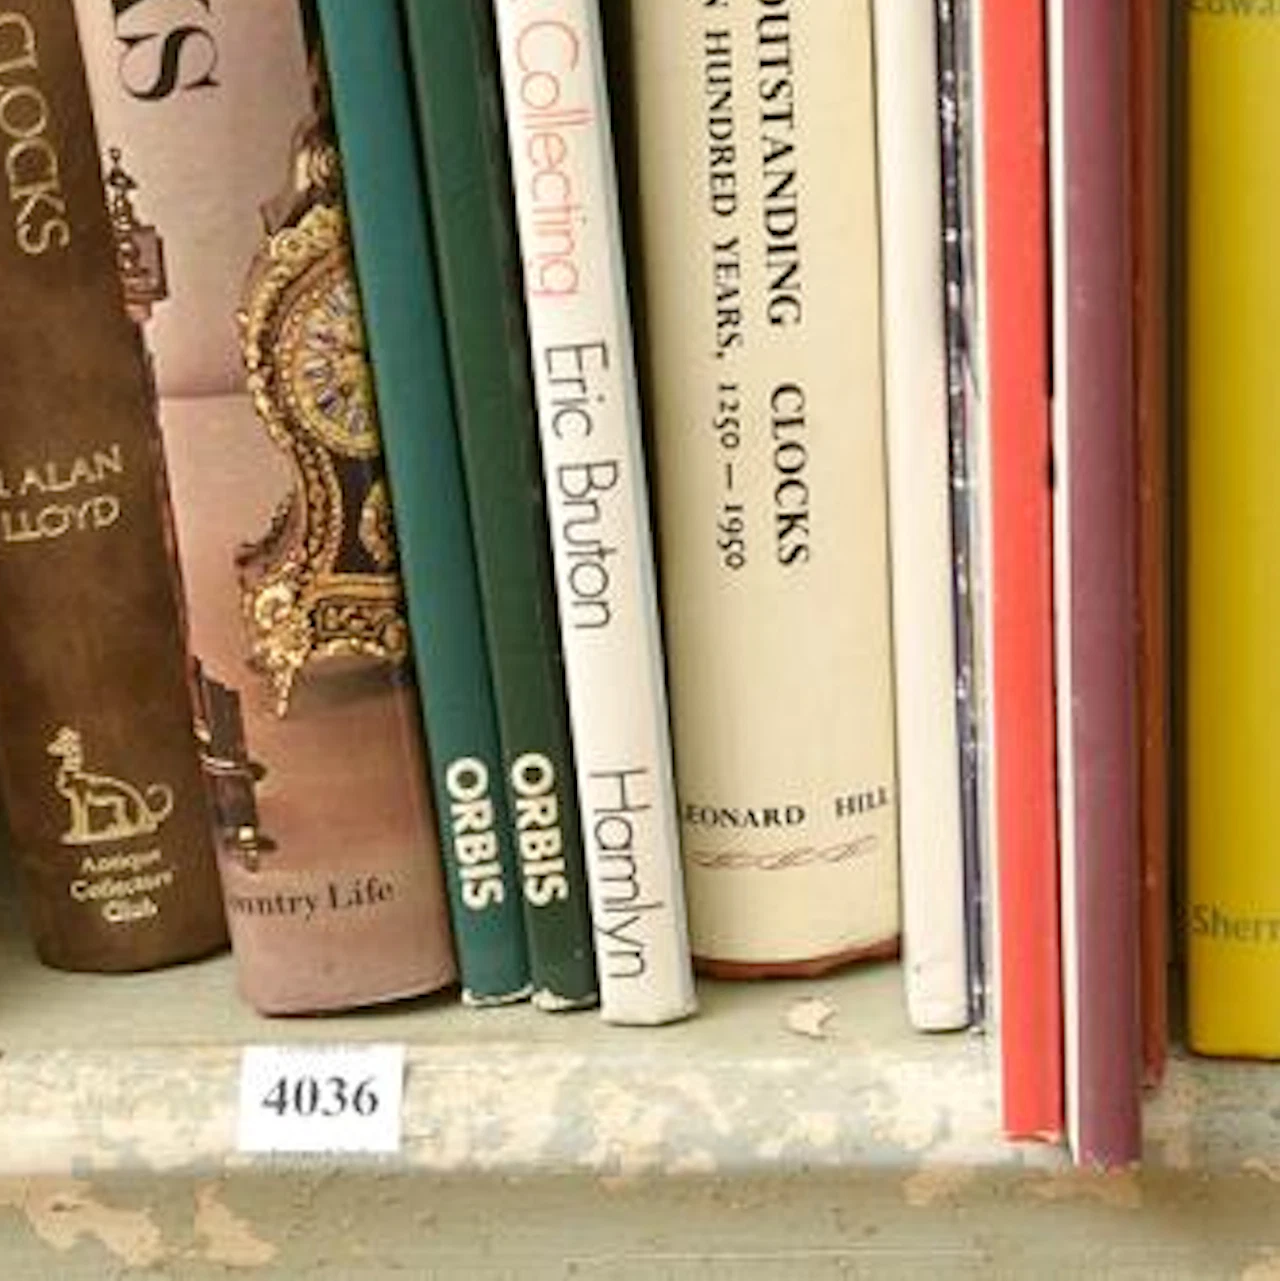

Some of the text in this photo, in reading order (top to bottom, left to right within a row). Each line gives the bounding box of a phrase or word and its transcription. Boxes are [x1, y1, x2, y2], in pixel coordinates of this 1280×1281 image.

[515, 19, 594, 300] Collecting
[703, 30, 739, 221] HUNDRED
[711, 236, 746, 360] YEARS,
[543, 338, 612, 441] Eric
[717, 382, 741, 452] 1250
[2, 494, 120, 543] LLOYD
[20, 443, 122, 494] ALAN
[770, 381, 811, 568] CLOCKS
[557, 458, 621, 631] Bruton
[721, 501, 747, 572] 1950
[445, 756, 504, 912] ORBIS
[510, 752, 569, 909] ORBIS
[683, 786, 891, 833] EONARD HILL
[231, 875, 396, 919] ountry Life
[589, 765, 665, 982] Hamlyn
[260, 1073, 381, 1118] 4036
